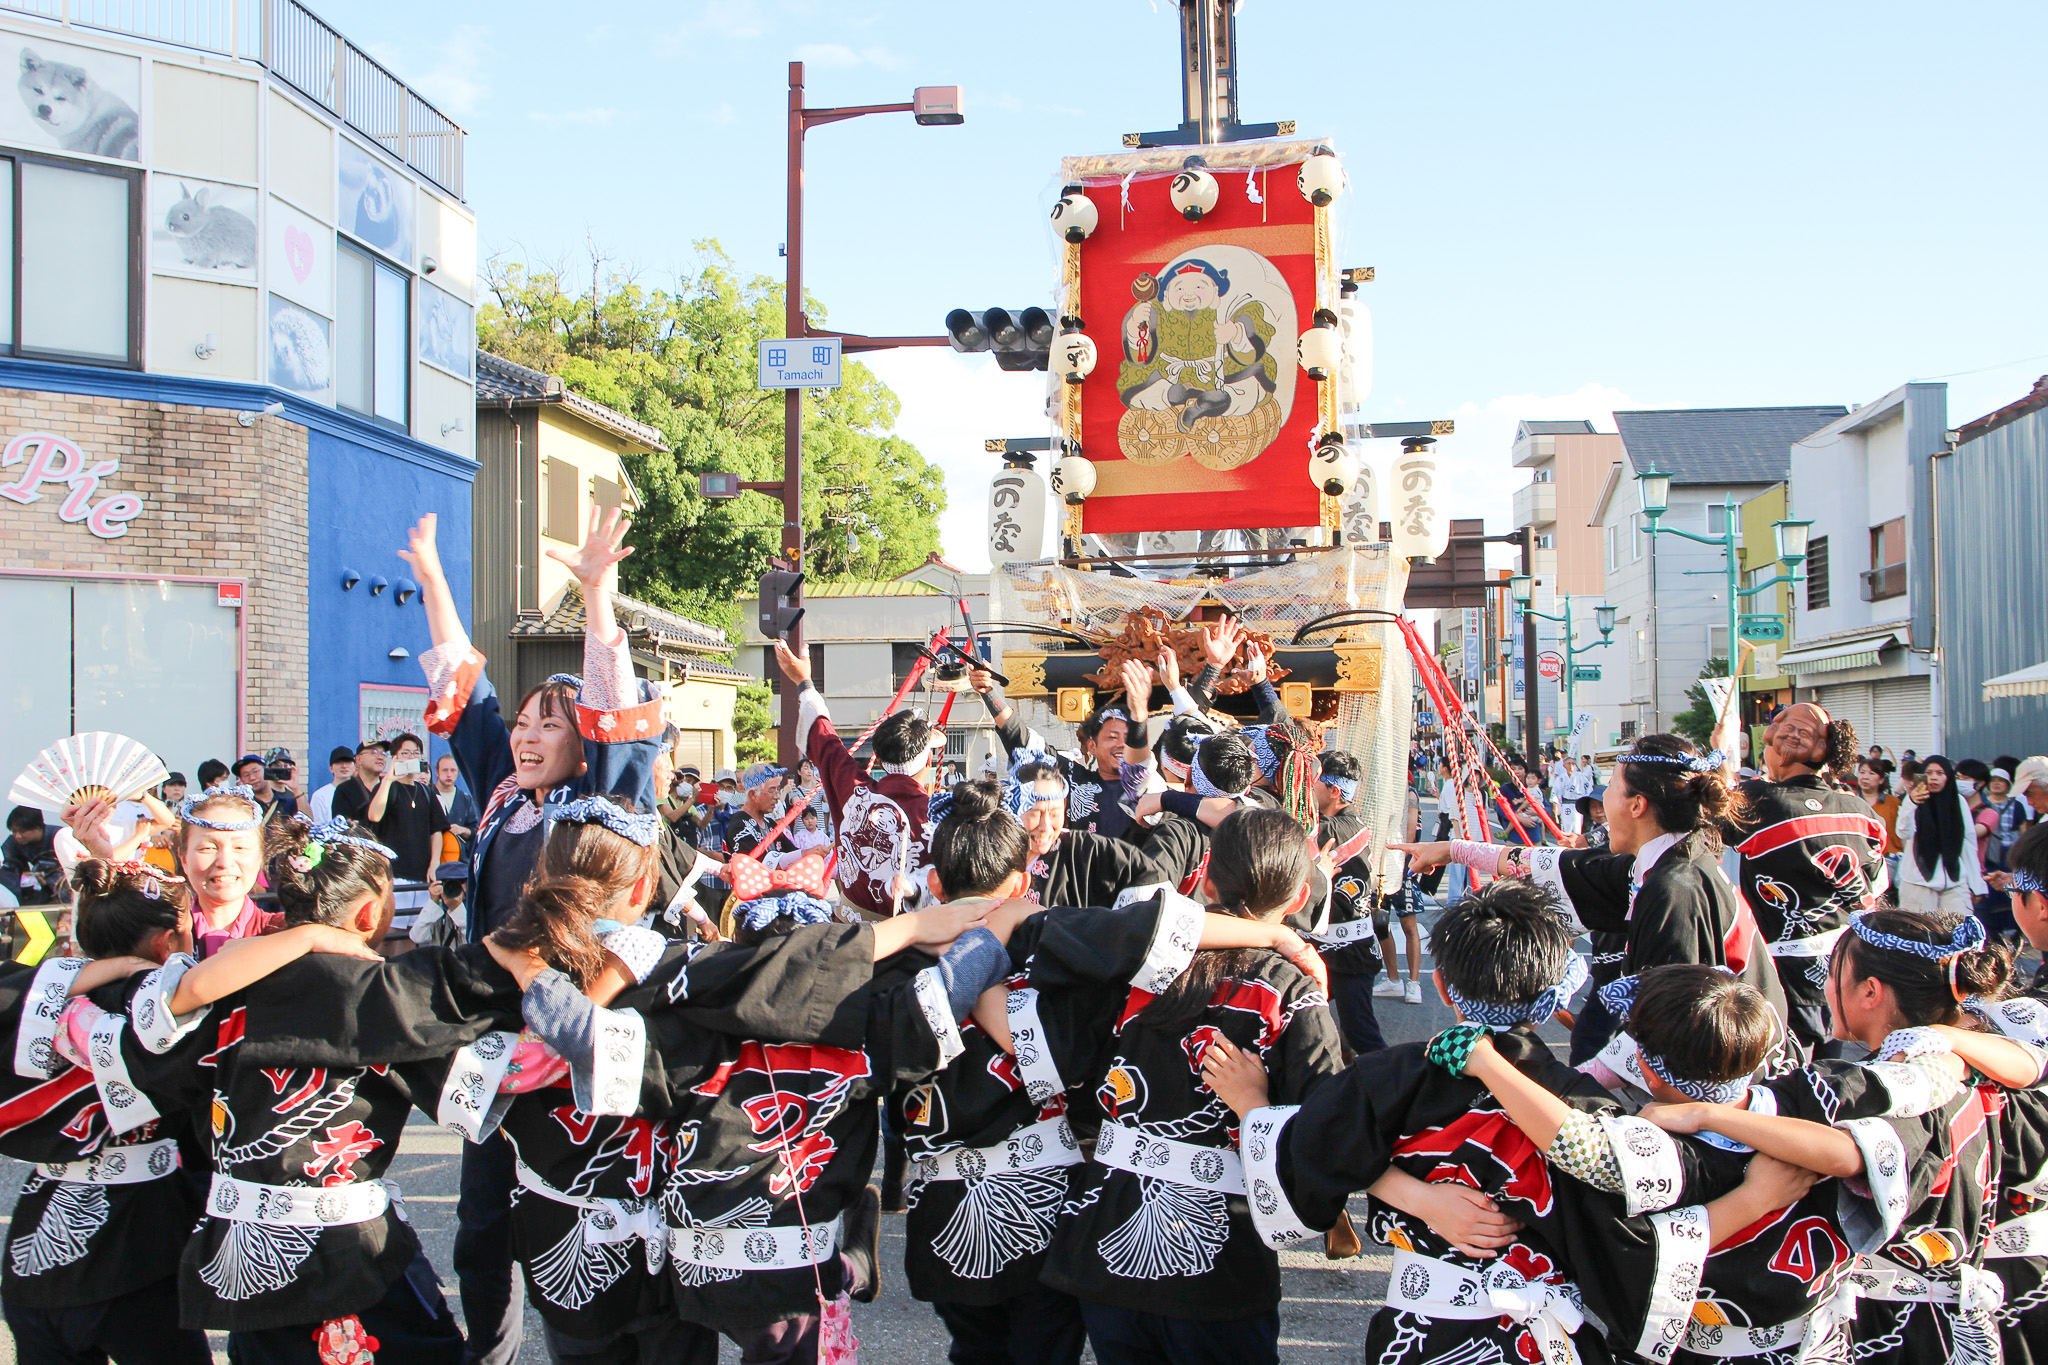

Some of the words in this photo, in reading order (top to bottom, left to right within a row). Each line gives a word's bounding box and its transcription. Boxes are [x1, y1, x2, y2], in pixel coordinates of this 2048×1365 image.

[768, 346, 832, 367] 田町
[777, 369, 823, 381] Tamachi
[0, 432, 144, 538] Pie
[1466, 636, 1478, 678] フセイ
